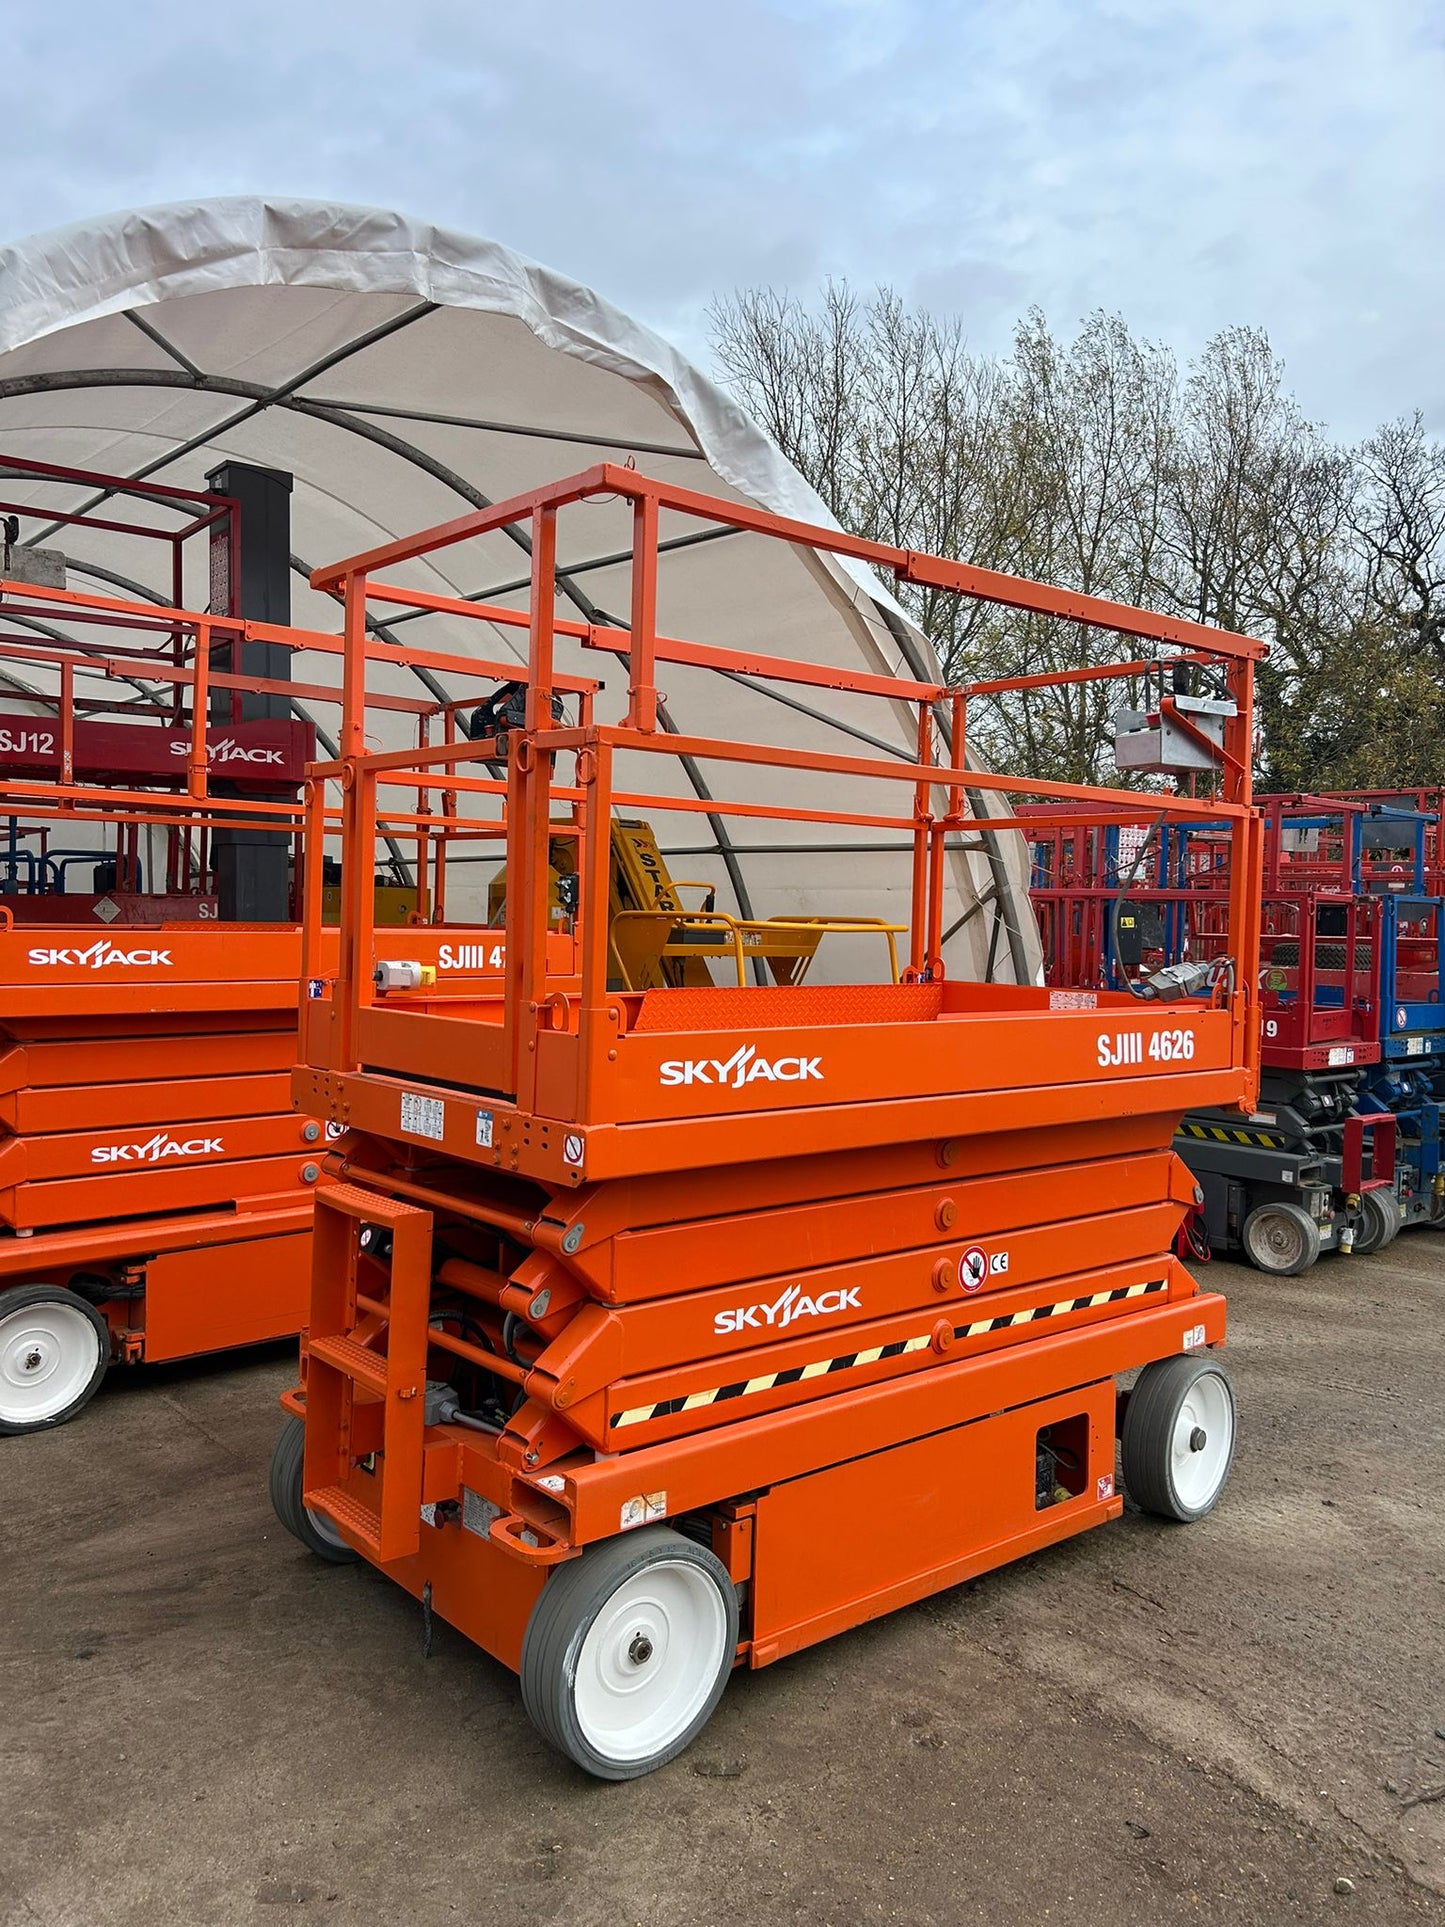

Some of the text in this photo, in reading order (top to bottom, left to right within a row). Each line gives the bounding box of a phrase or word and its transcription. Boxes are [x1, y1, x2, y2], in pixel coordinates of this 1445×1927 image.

[0, 729, 54, 755] SJ12
[28, 940, 173, 968] SKYJACK
[438, 945, 484, 969] SJIII
[1097, 1029, 1195, 1067] SJIII 4626
[659, 1043, 825, 1089] SKYJACK
[91, 1133, 225, 1163] SKYJACK
[991, 1253, 1007, 1272] CE
[714, 1283, 863, 1335] SKYJACK
